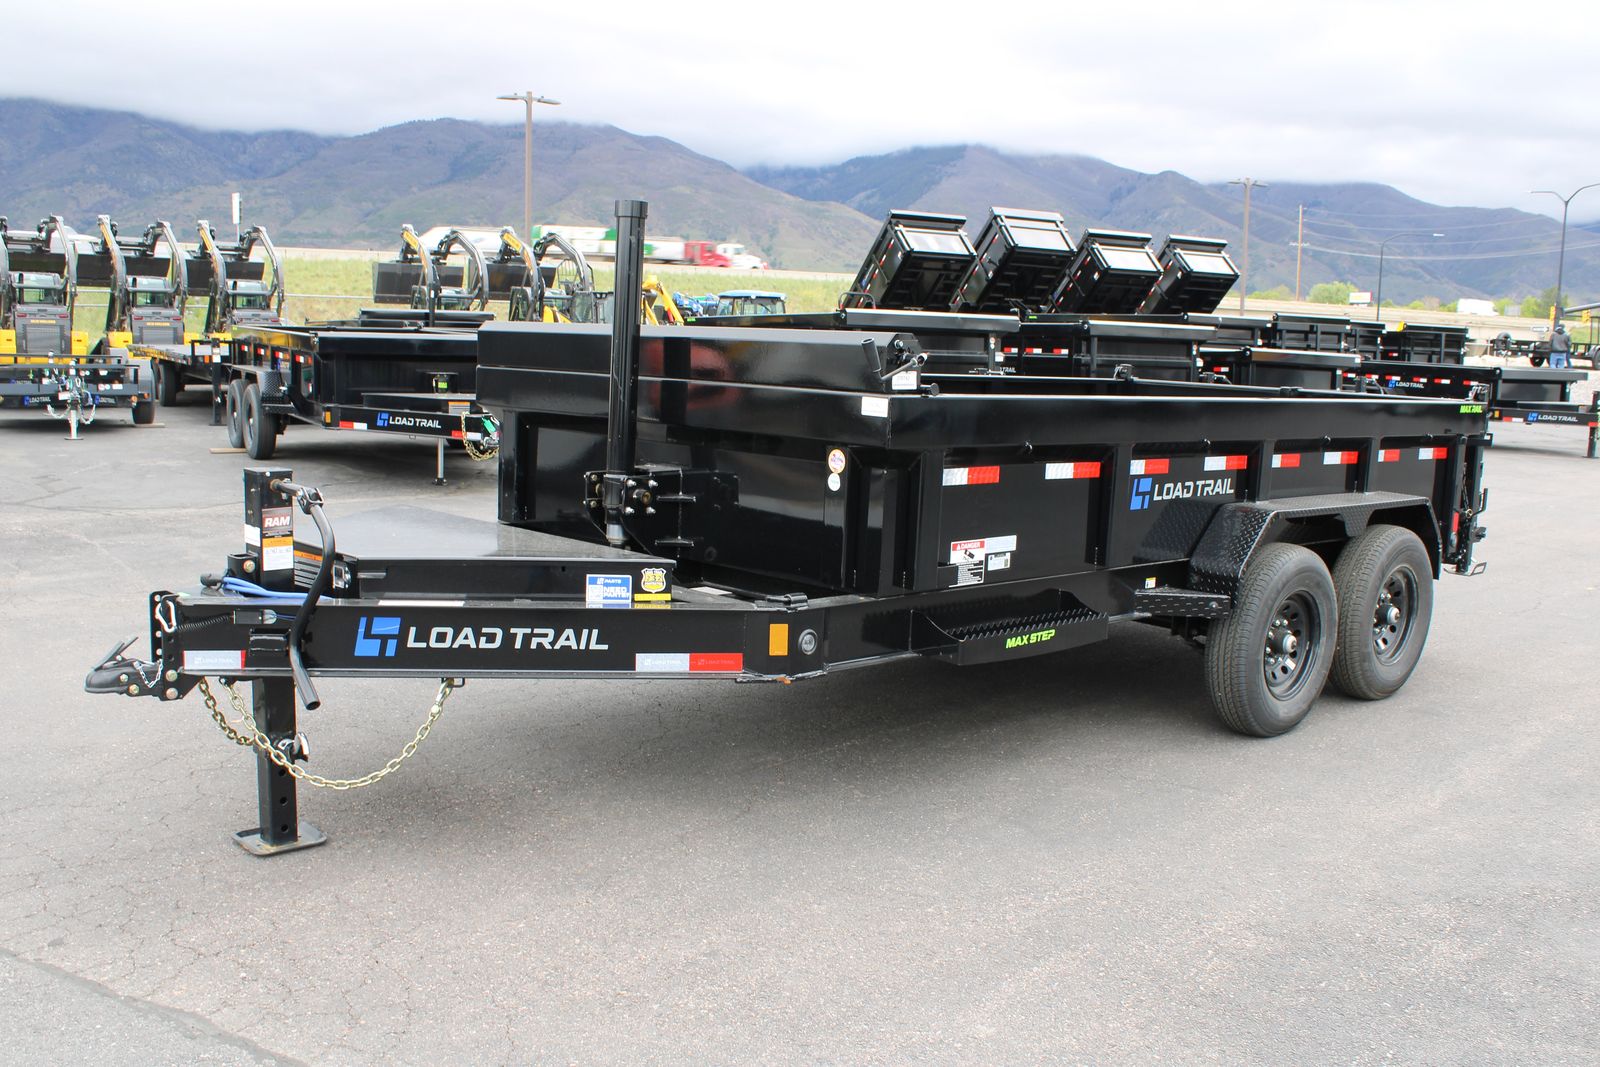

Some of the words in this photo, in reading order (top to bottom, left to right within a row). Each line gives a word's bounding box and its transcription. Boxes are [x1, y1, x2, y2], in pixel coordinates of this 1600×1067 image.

[389, 416, 414, 426] LOAD
[415, 418, 442, 429] TRAIL
[1153, 481, 1194, 501] LOAD
[1196, 477, 1235, 497] TRAIL
[264, 515, 291, 528] RAM
[406, 626, 503, 649] LOAD
[509, 626, 609, 650] TRAIL
[1005, 634, 1029, 649] MAX
[1030, 629, 1056, 644] STEP
